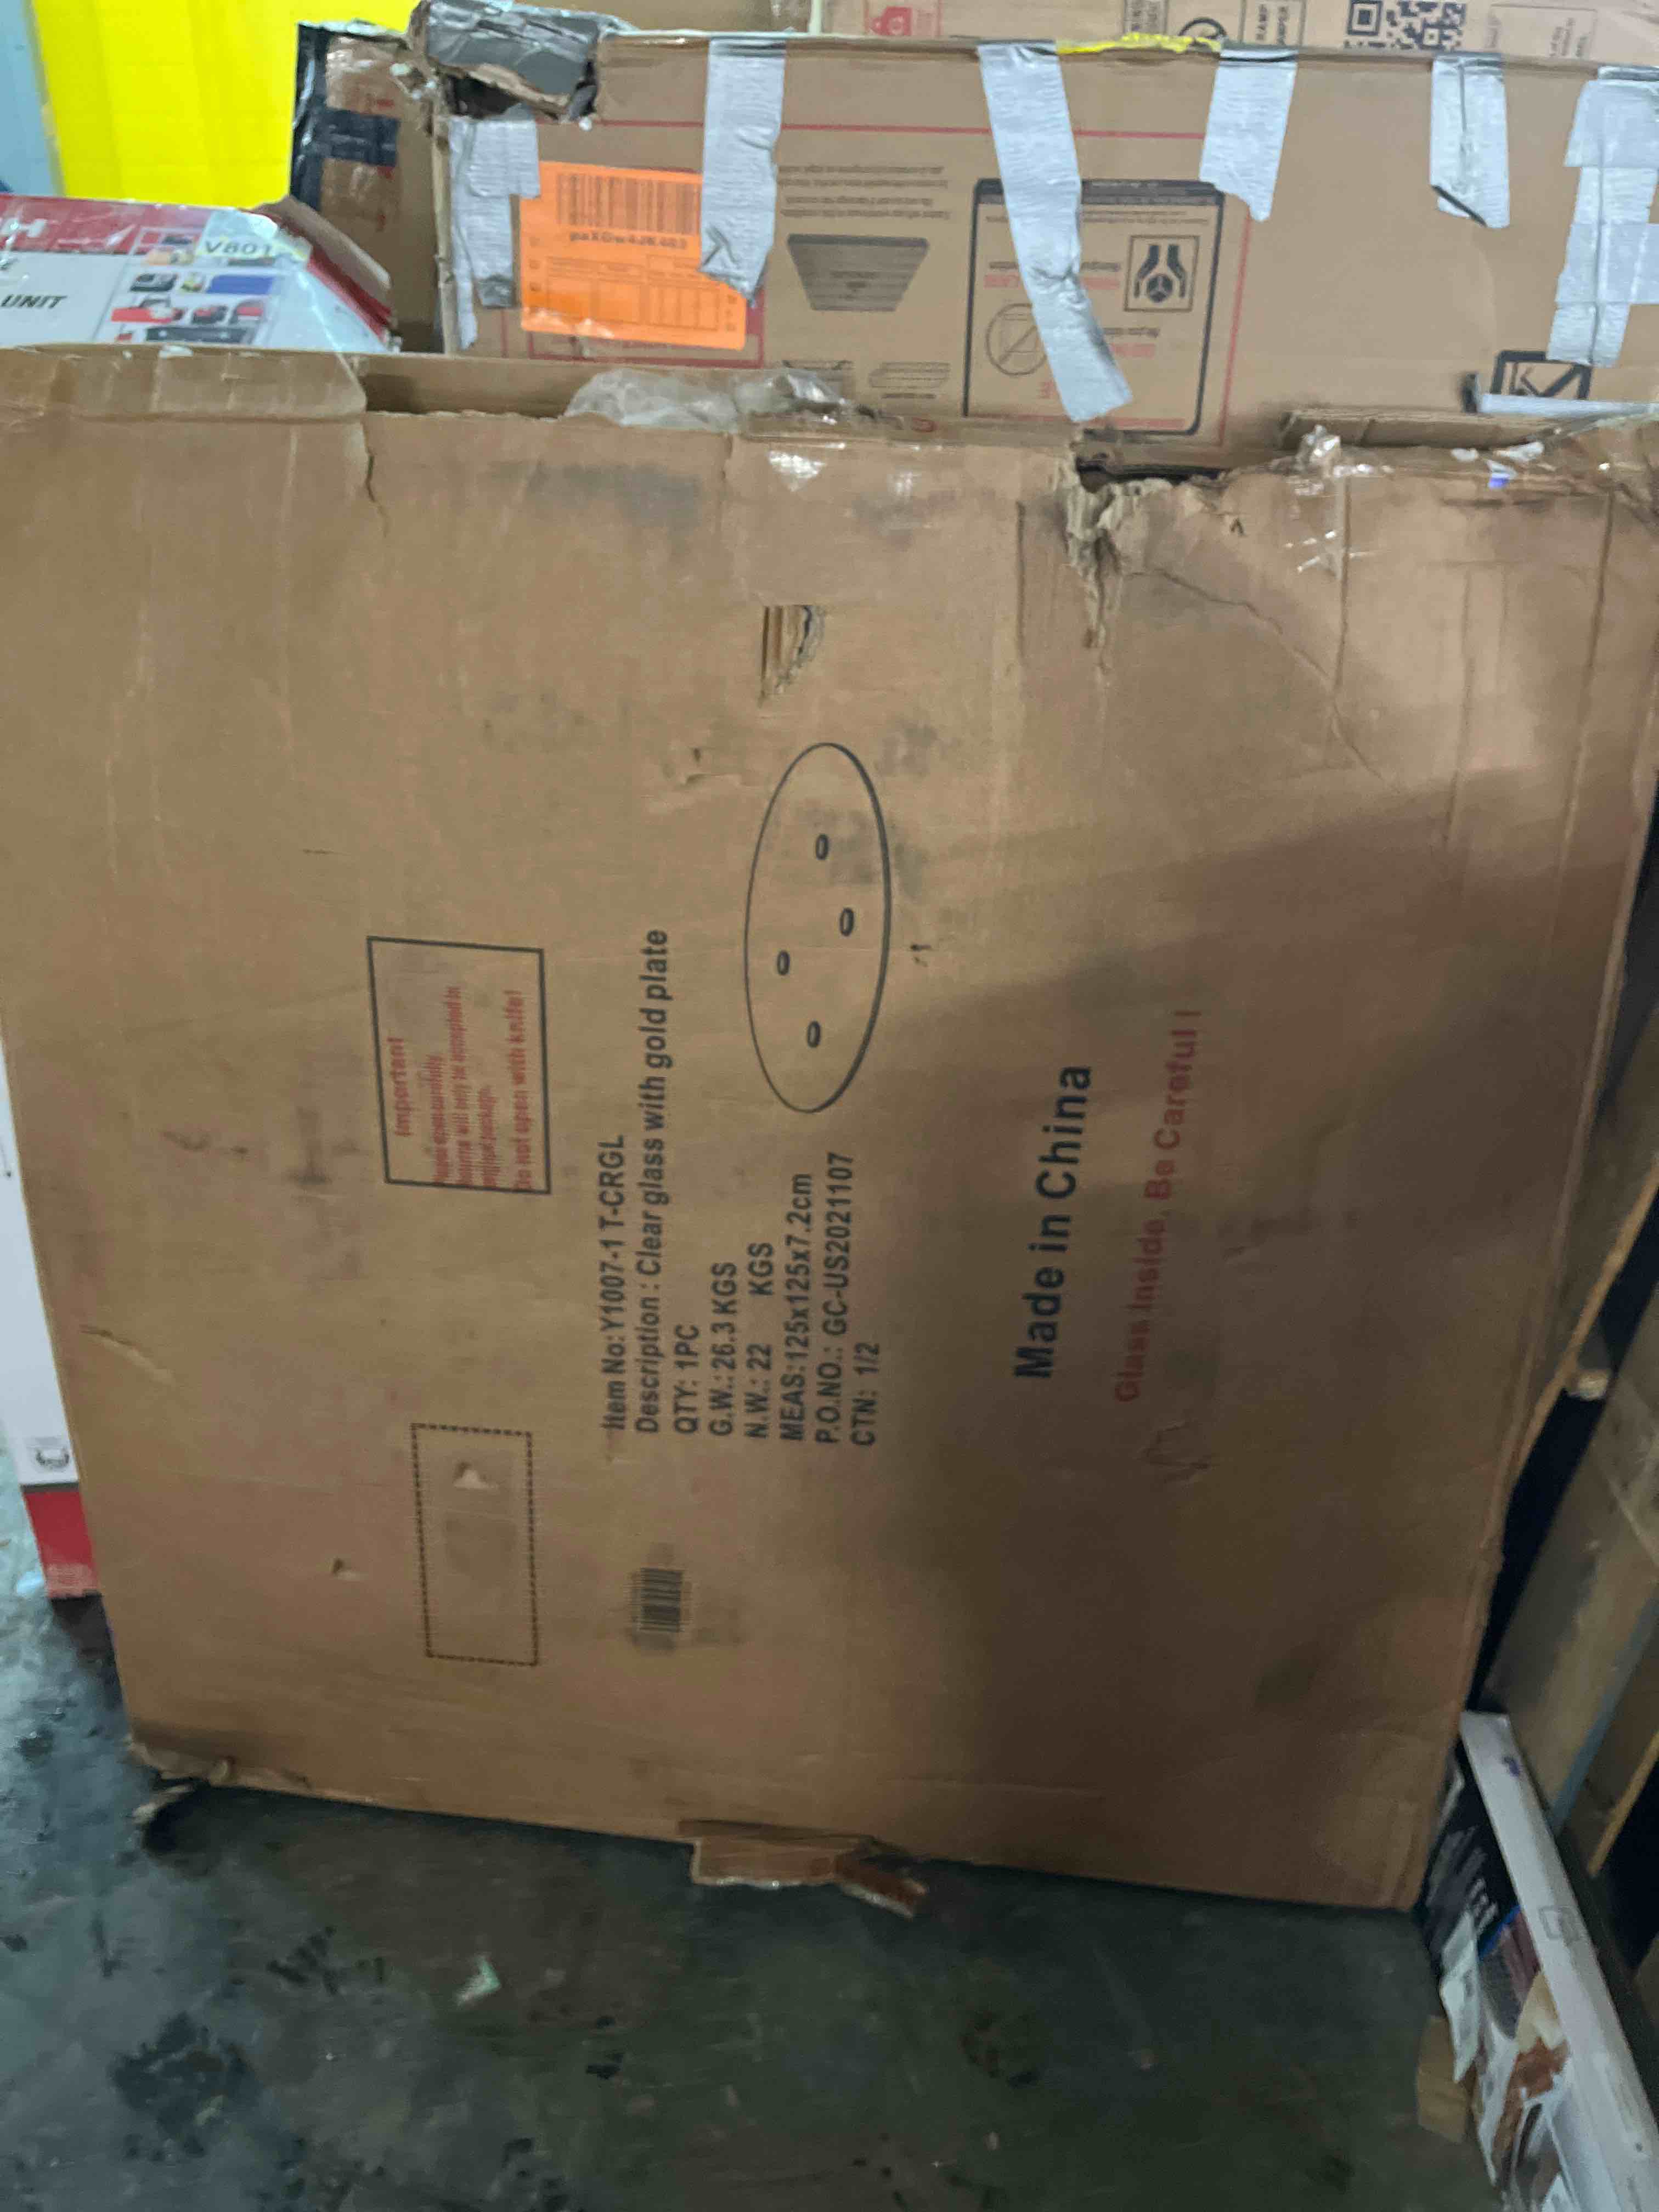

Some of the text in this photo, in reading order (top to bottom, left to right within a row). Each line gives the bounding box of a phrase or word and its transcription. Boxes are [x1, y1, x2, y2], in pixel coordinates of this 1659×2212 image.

[1, 294, 67, 309] UNIT
[640, 929, 672, 1001] plate
[504, 1048, 528, 1085] with
[638, 1008, 673, 1069] gold
[509, 1090, 533, 1133] open
[637, 1076, 667, 1131] with
[510, 1137, 532, 1165] not
[637, 1137, 670, 1205] glass
[598, 1134, 625, 1232] T-CRGL
[636, 1212, 664, 1276] Clear
[821, 1152, 853, 1336] GC-US2021107
[1013, 1064, 1093, 1380] Made in China
[712, 1261, 738, 1314] KGS
[748, 1241, 774, 1296] KGS
[1114, 1318, 1152, 1403] Glass
[1143, 1158, 1175, 1200] Be
[674, 1324, 702, 1435] QTY: 1PC
[747, 1342, 773, 1372] 22
[600, 1380, 628, 1431] Item
[852, 1341, 880, 1447] CTN: 1/2
